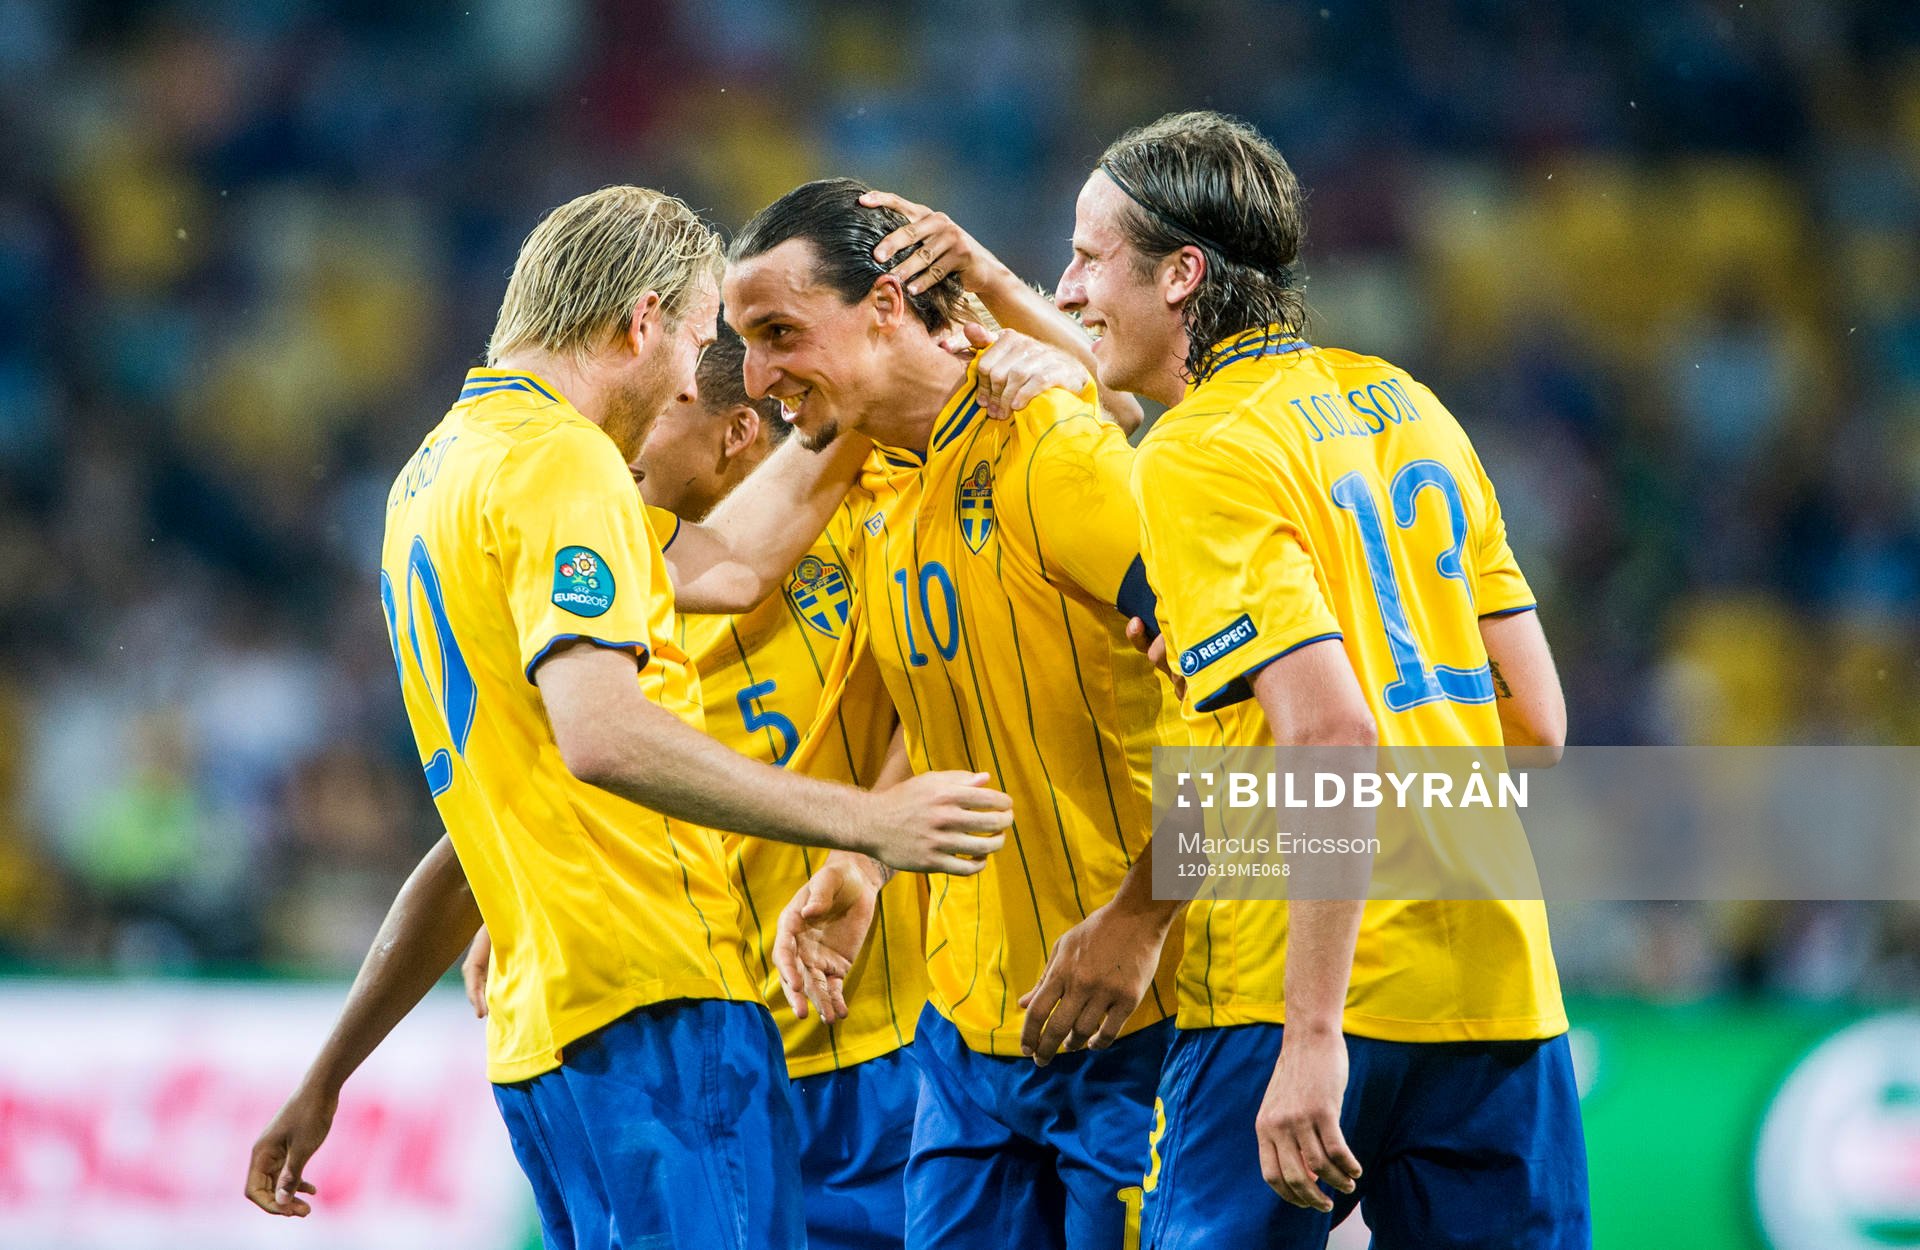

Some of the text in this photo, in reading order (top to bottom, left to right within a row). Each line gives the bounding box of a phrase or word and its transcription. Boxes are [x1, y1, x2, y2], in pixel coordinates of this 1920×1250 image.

[1290, 378, 1421, 441] J.OLSON
[894, 561, 960, 667] 10
[1331, 459, 1496, 713] 13
[1198, 620, 1252, 660] RESPECT
[736, 679, 800, 767] 5
